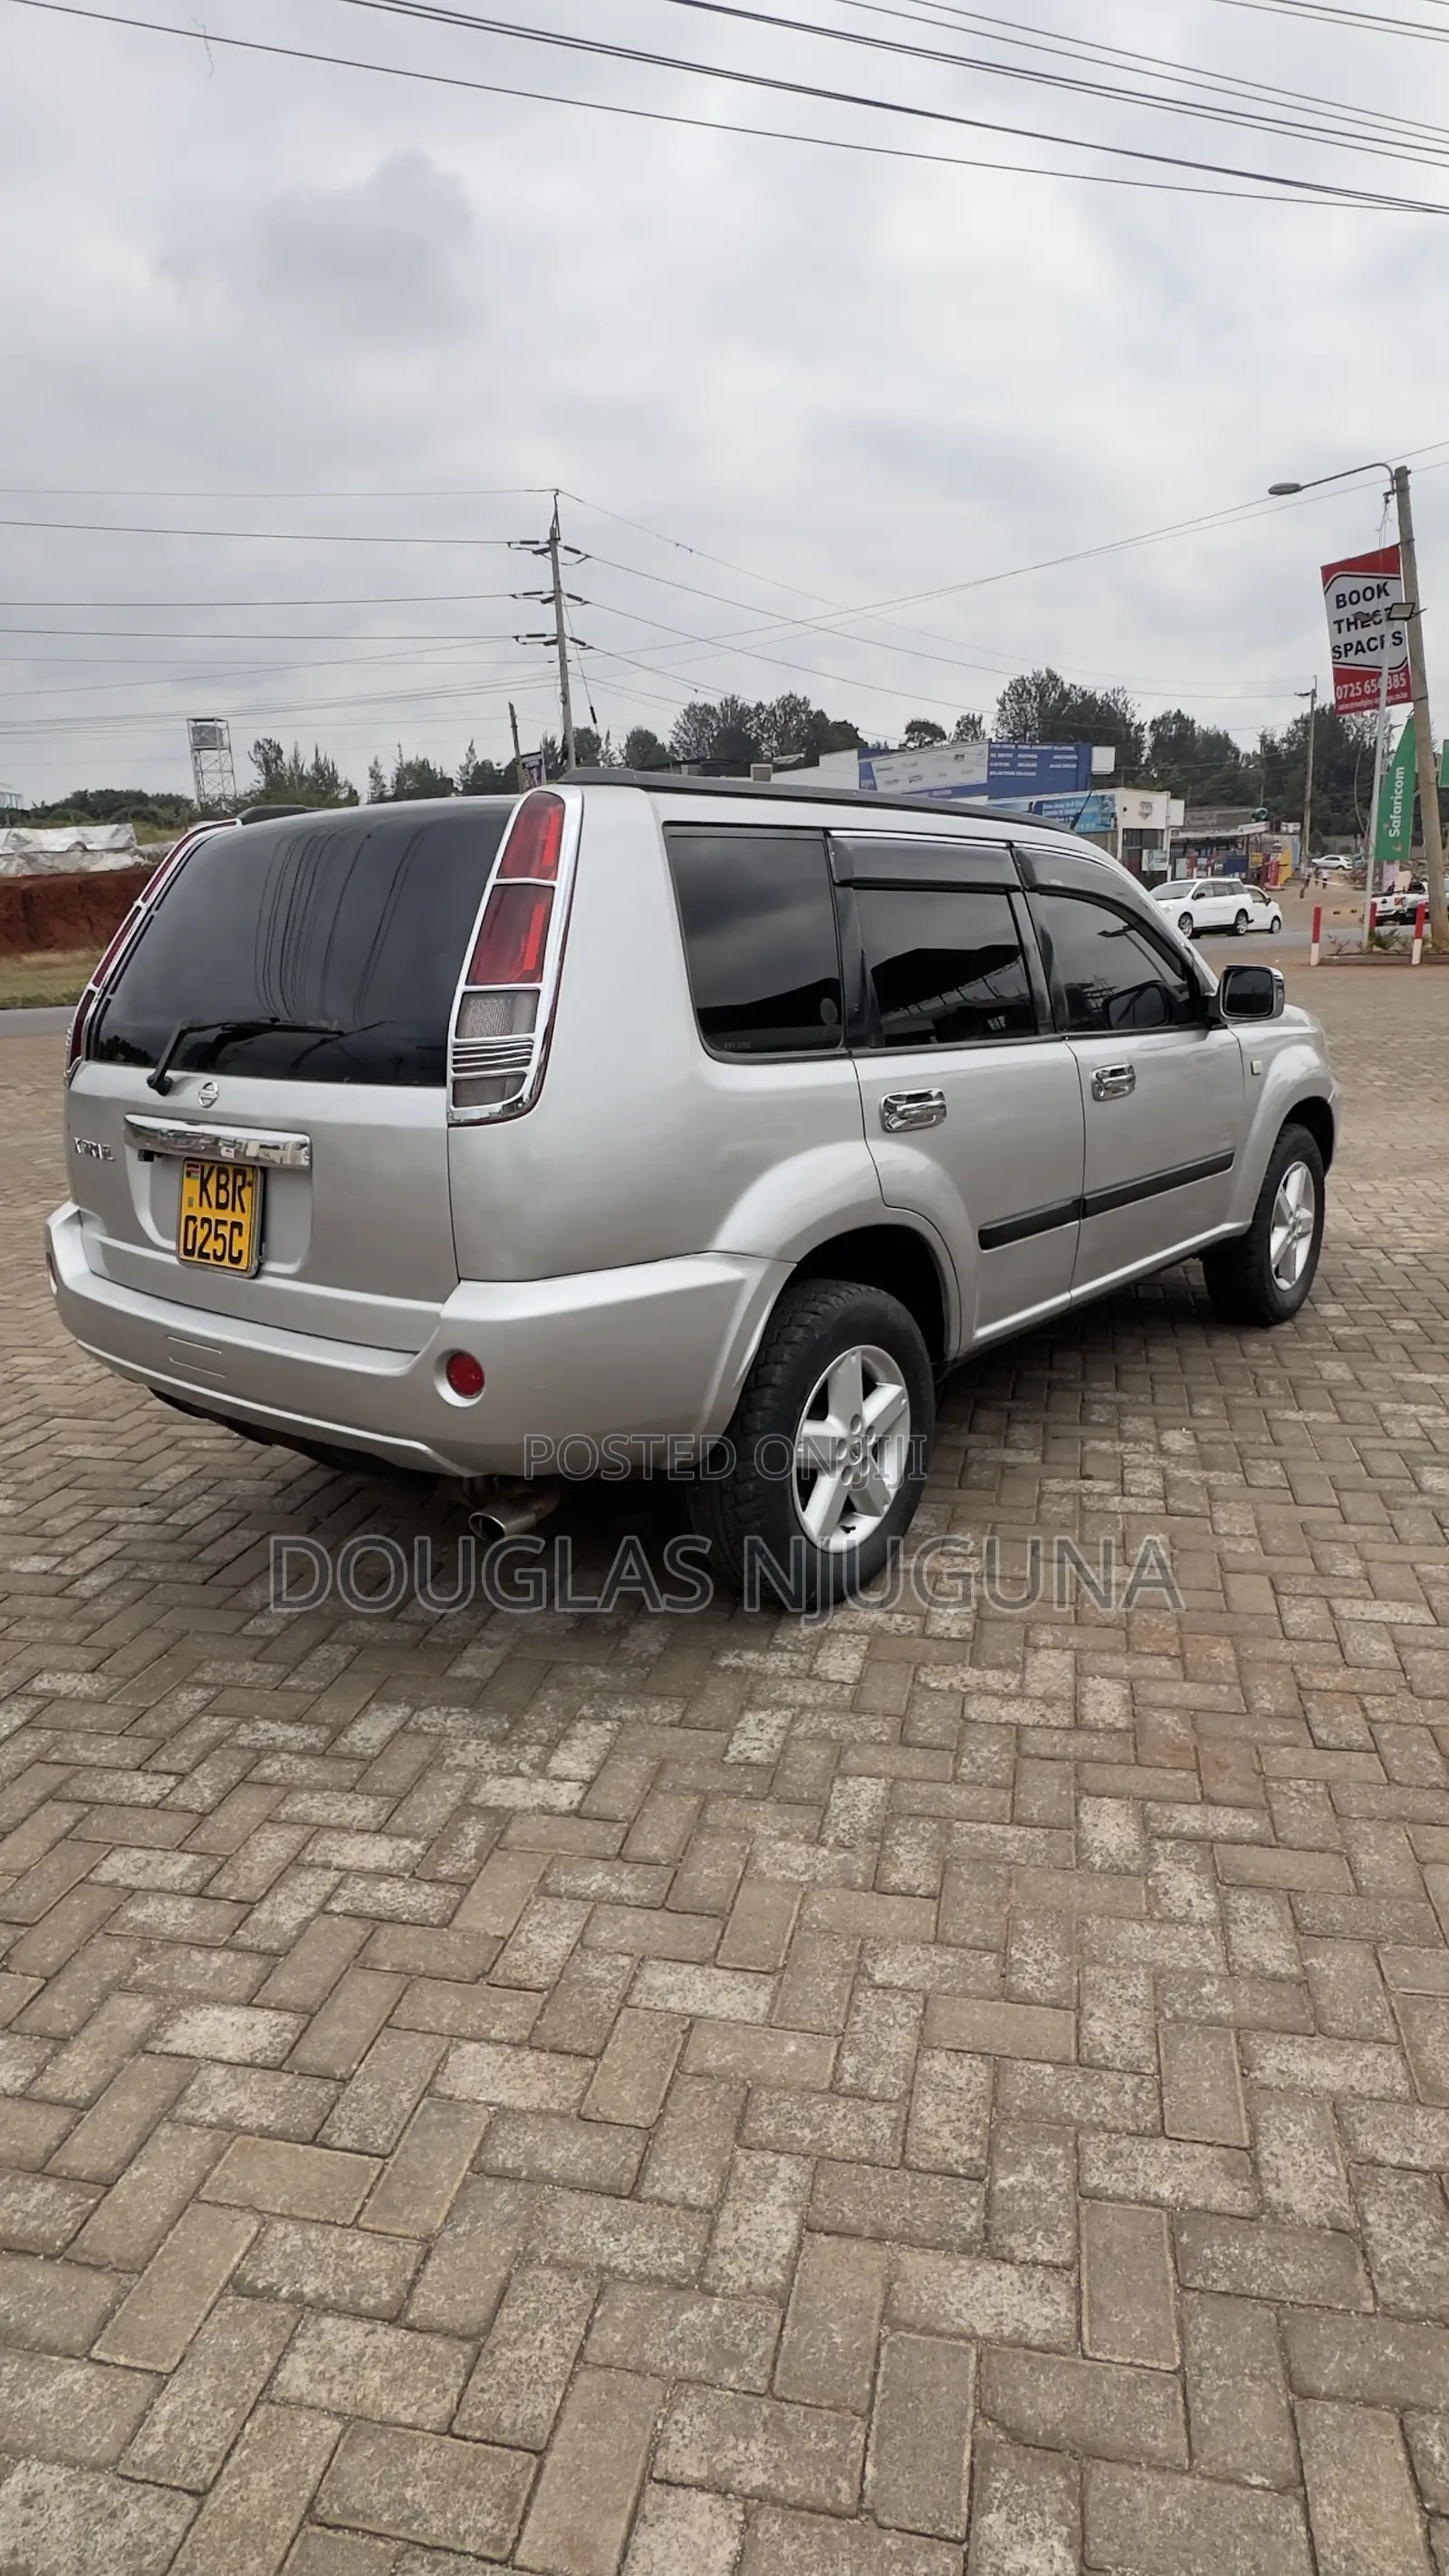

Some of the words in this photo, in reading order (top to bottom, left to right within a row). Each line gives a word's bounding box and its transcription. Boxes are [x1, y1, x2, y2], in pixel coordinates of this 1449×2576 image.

[1335, 581, 1390, 609] BOOK
[1336, 681, 1362, 700] 0725
[1388, 766, 1405, 838] Safaricom
[198, 1164, 247, 1214] KBR
[183, 1214, 244, 1265] 025C
